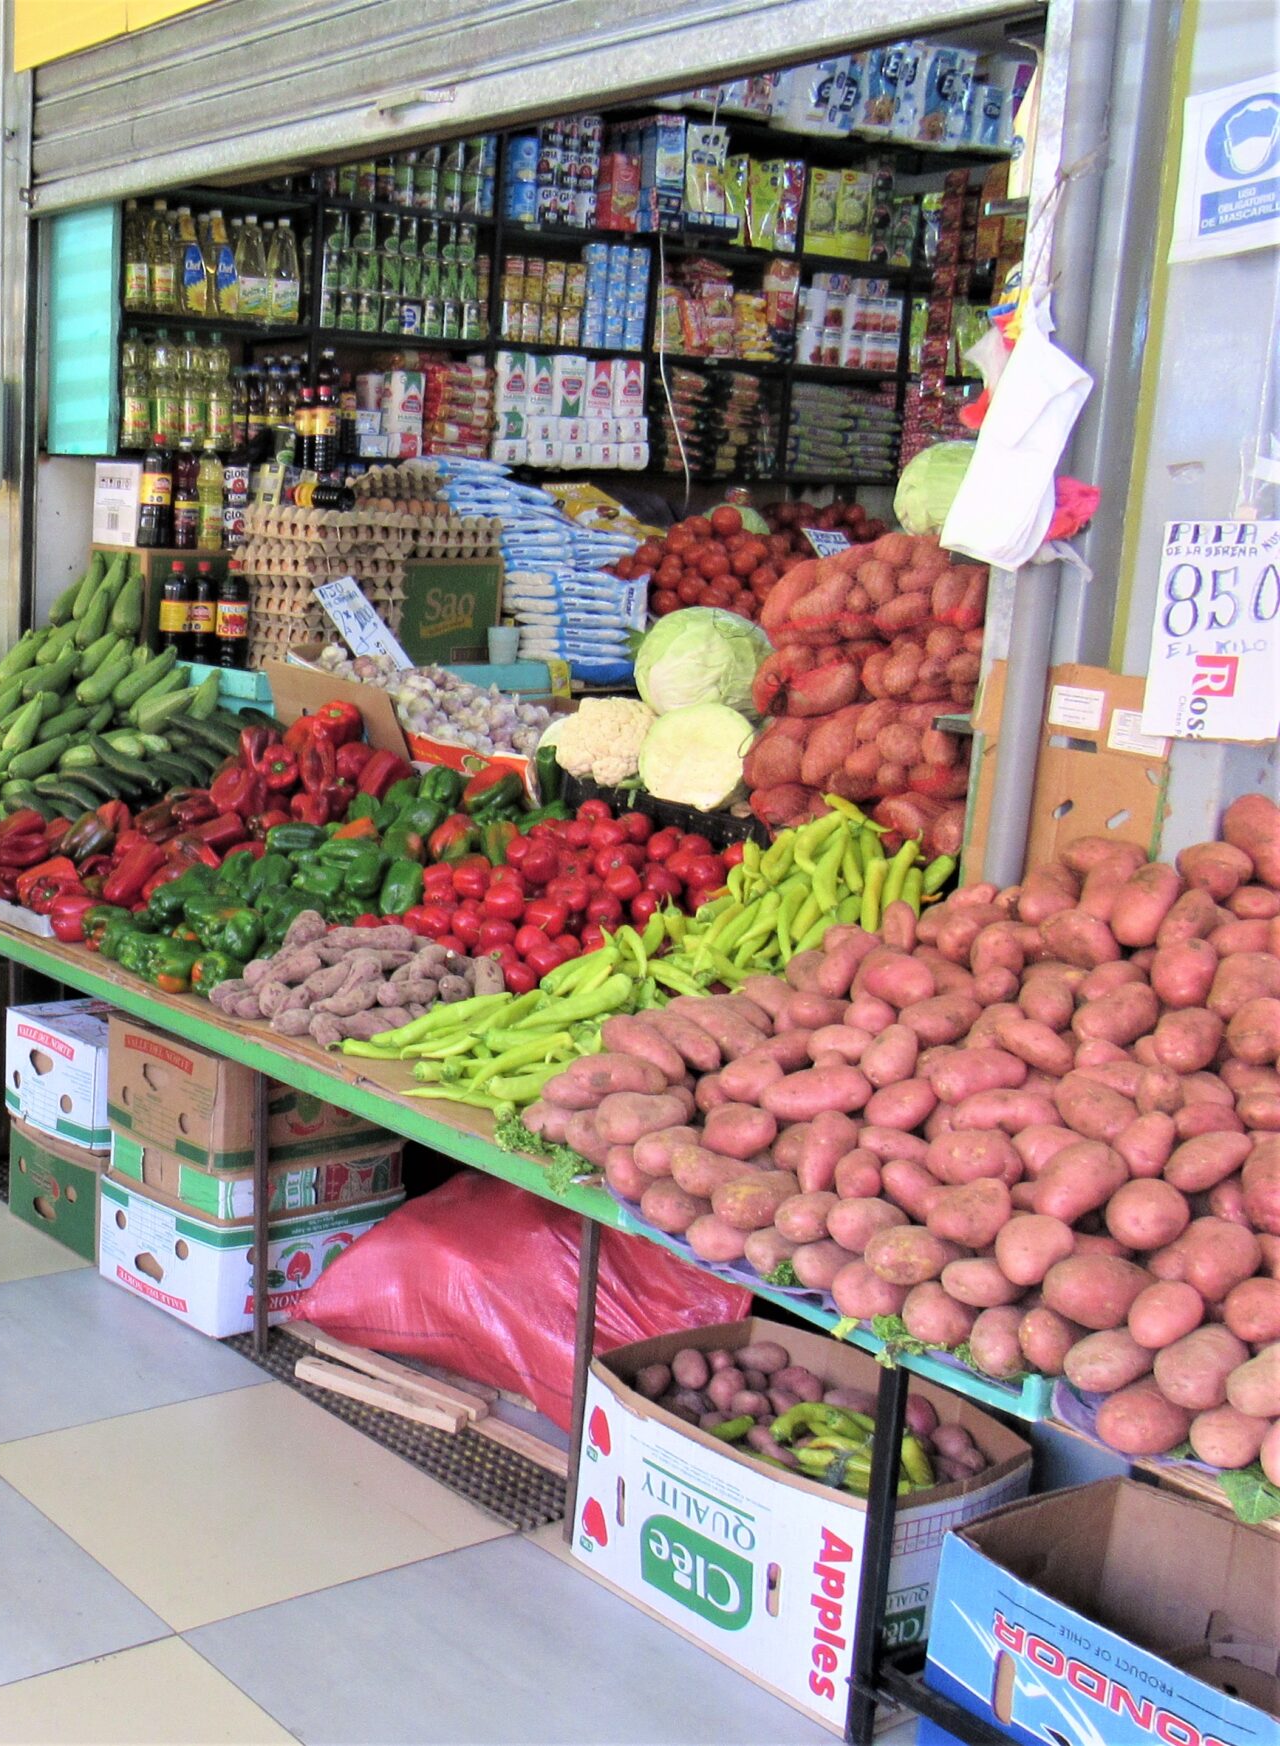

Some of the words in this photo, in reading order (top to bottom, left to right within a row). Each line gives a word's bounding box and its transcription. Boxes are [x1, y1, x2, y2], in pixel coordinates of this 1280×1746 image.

[1218, 192, 1276, 215] OBLIGATORIO
[1238, 187, 1257, 200] USO
[1201, 216, 1216, 230] DE
[1218, 202, 1280, 225] MASCARILL
[1166, 546, 1182, 557] DE
[1186, 545, 1202, 556] LA
[1205, 546, 1258, 558] SERENA
[425, 588, 475, 621] Sao
[1163, 563, 1280, 637] 850
[1166, 642, 1198, 660] EL
[1215, 640, 1269, 655] KILO
[19, 1025, 38, 1040] VALLE
[37, 1031, 51, 1044] DEL
[50, 1037, 72, 1059] NORTE
[126, 1036, 149, 1052] VALLE
[148, 1043, 163, 1057] DEL
[163, 1050, 190, 1071] NORTE
[119, 1270, 144, 1294] NORTE
[161, 1294, 187, 1311] VALLE
[641, 1472, 756, 1551] QUALITY
[885, 1586, 930, 1610] QUALI
[808, 1526, 854, 1701] Apples
[1058, 1624, 1091, 1648] CHILE
[1094, 1644, 1112, 1661] OF
[992, 1608, 1230, 1746] ONDOR
[1116, 1658, 1174, 1698] PRODUCT
